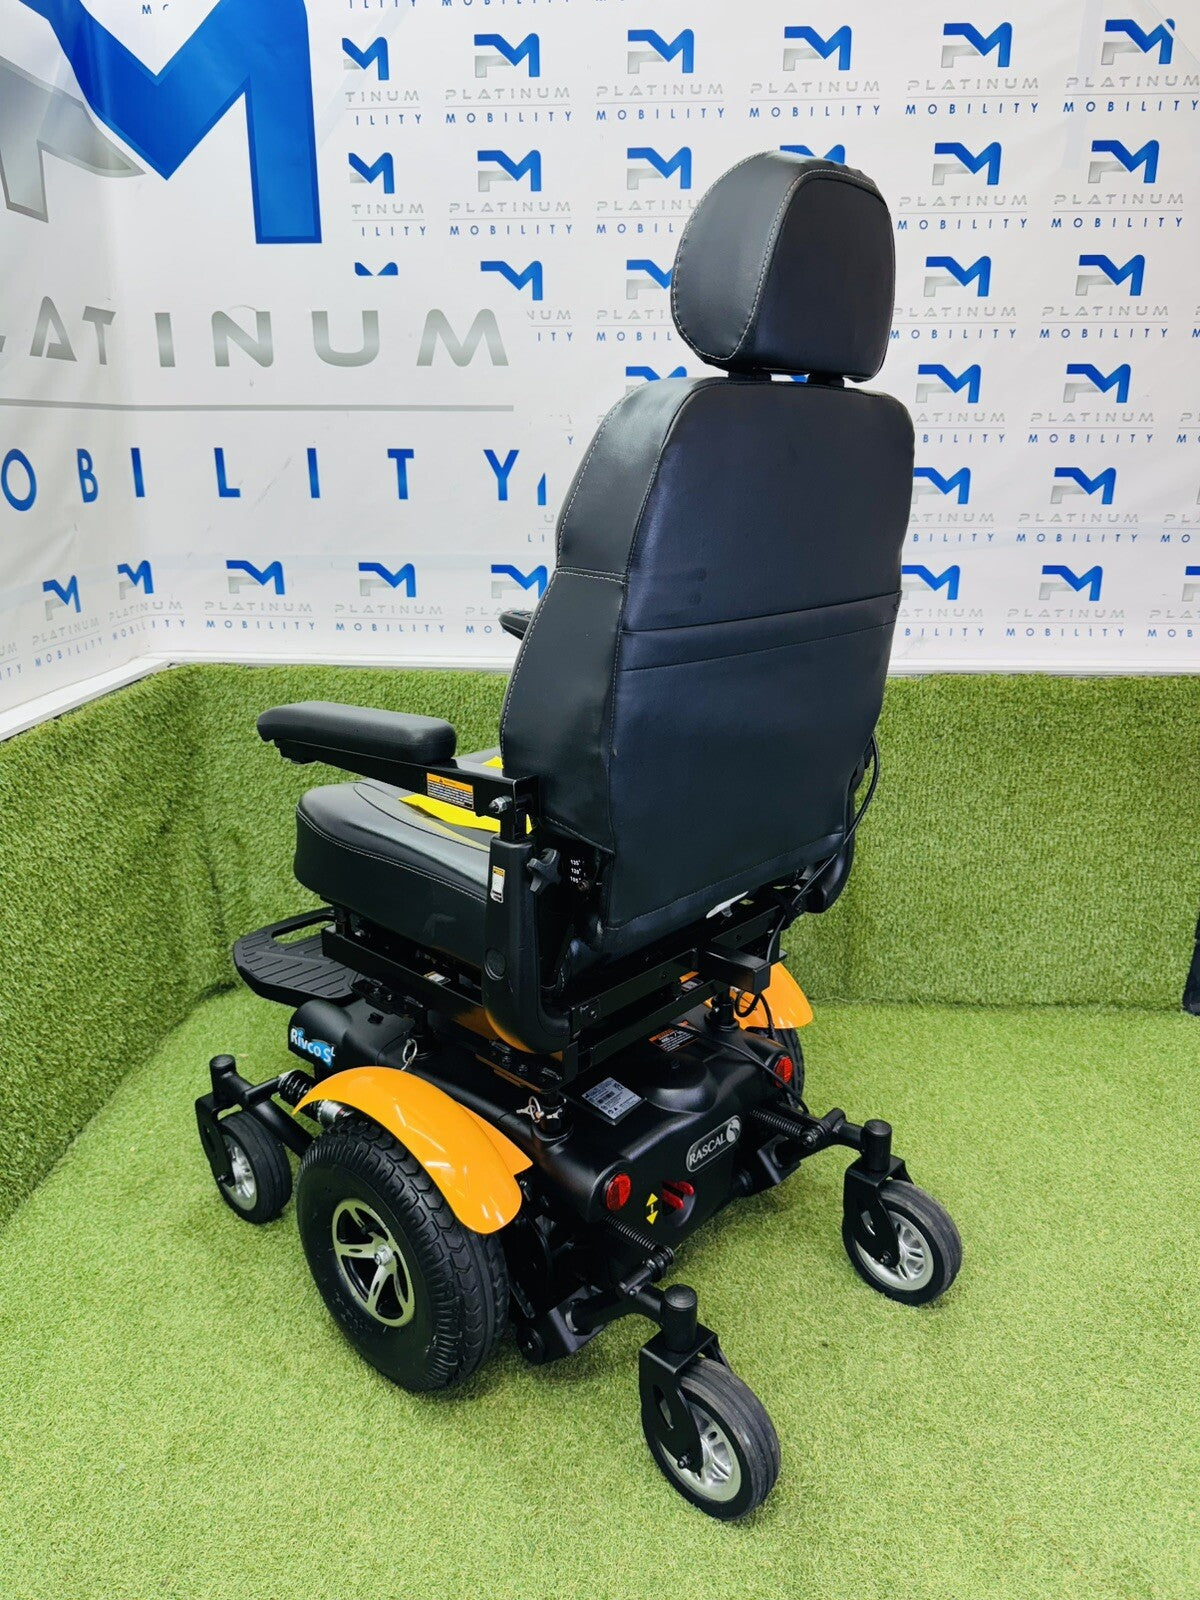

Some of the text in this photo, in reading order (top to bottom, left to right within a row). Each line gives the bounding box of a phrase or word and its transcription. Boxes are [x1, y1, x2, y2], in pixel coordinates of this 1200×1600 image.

[908, 78, 1038, 90] PLATINUM
[1067, 75, 1199, 87] PLATINUM
[597, 84, 723, 96] PLATINUM
[751, 81, 879, 93] PLATINUM
[446, 87, 569, 99] PLATINUM
[750, 106, 879, 117] MOBILITY
[906, 103, 1037, 114] MOBILITY
[1063, 100, 1198, 112] MOBILITY
[446, 111, 571, 123] MOBILITY
[597, 108, 724, 120] MOBILITY
[900, 195, 1027, 206] PLATINUM
[1055, 193, 1183, 204] PLATINUM
[449, 202, 570, 213] PLATINUM
[898, 219, 1026, 229] MOBILITY
[1052, 218, 1182, 227] MOBILITY
[450, 225, 571, 235] MOBILITY
[596, 223, 673, 234] MOBIL
[596, 309, 671, 321] PLATI
[893, 306, 1018, 318] PLATINUM
[1043, 306, 1168, 316] PLATINUM
[0, 296, 510, 369] ATINUM
[596, 332, 672, 342] MOBIL
[890, 328, 1017, 340] MOBILITY
[1040, 329, 1167, 338] MOBILITY
[1031, 413, 1153, 423] PLATINUM
[923, 434, 1004, 443] BILITY
[1029, 434, 1153, 443] MOBILITY
[1, 446, 520, 512] OBILITY
[1019, 513, 1138, 524] PLATINUM
[913, 534, 993, 542] BILITY
[1017, 534, 1137, 542] MOBILITY
[109, 601, 183, 622] PLATINUM
[205, 601, 312, 615] PLATINUM
[335, 604, 442, 614] PLATINUM
[1008, 609, 1124, 618] PLATINUM
[113, 619, 186, 641] MOBILITY
[207, 620, 314, 629] MOBILITY
[336, 623, 444, 632] MOBILITY
[33, 617, 100, 646] PLATINUM
[1007, 628, 1123, 636] MOBILITY
[35, 637, 103, 668] MOBILITY
[690, 1133, 726, 1166] RASCAL
